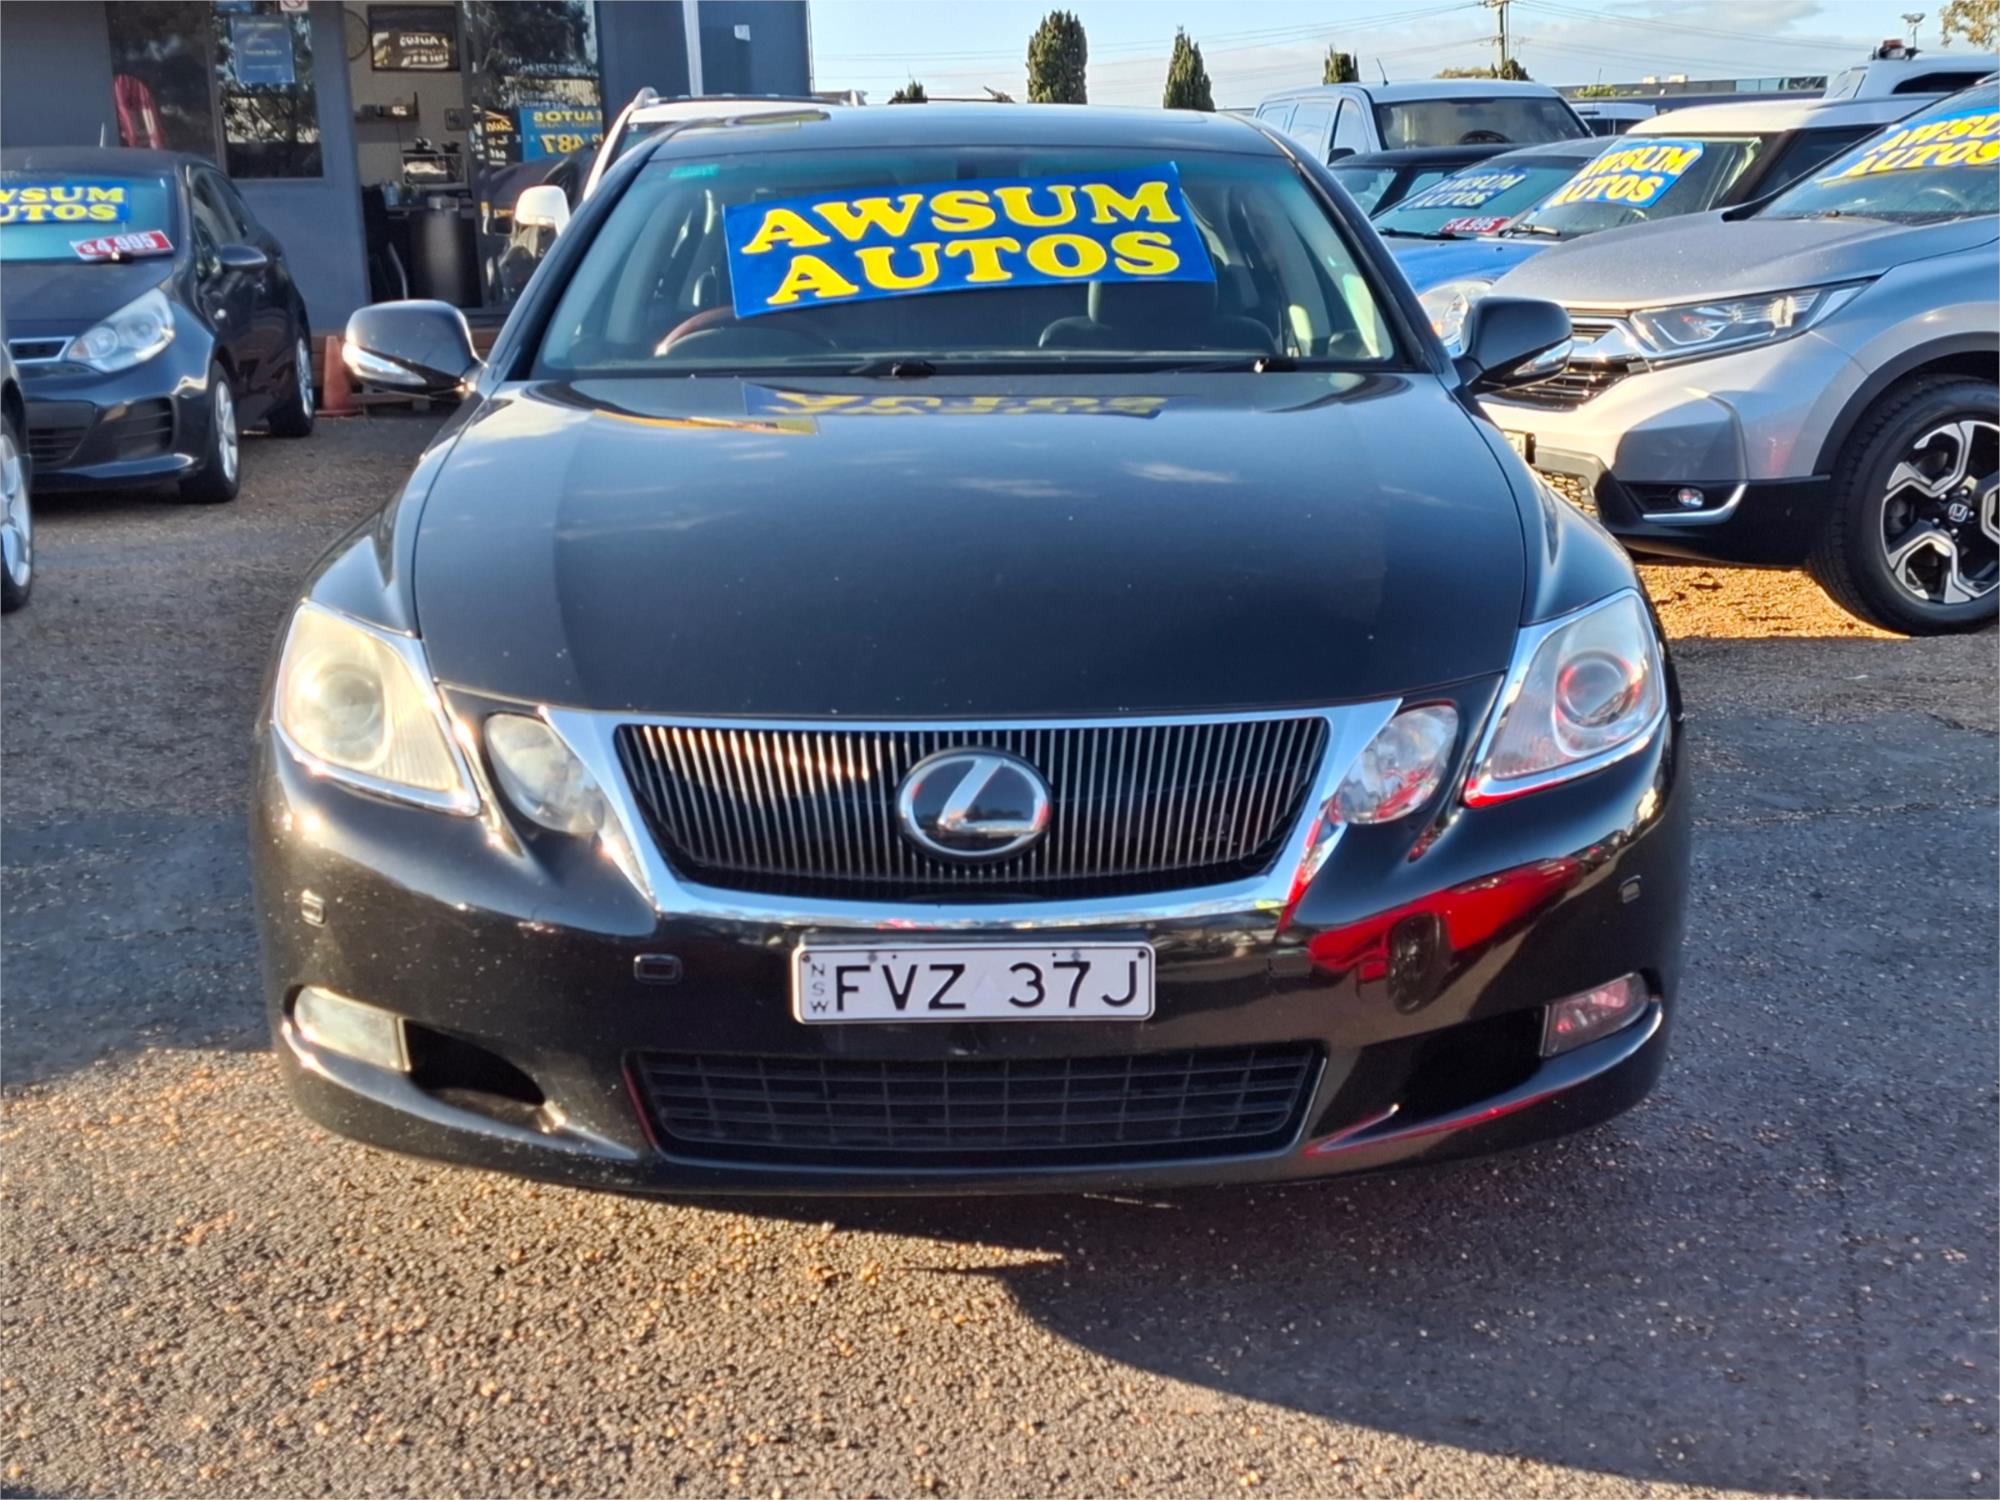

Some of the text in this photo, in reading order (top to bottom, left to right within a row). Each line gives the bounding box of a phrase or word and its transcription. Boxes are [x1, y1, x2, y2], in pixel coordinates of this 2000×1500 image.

[1551, 174, 1664, 206] AUTOS
[741, 181, 1181, 254] AWSUM
[766, 231, 1181, 304] AUTOS
[810, 963, 829, 1014] NSW
[836, 960, 1138, 1012] FVZ 37J
